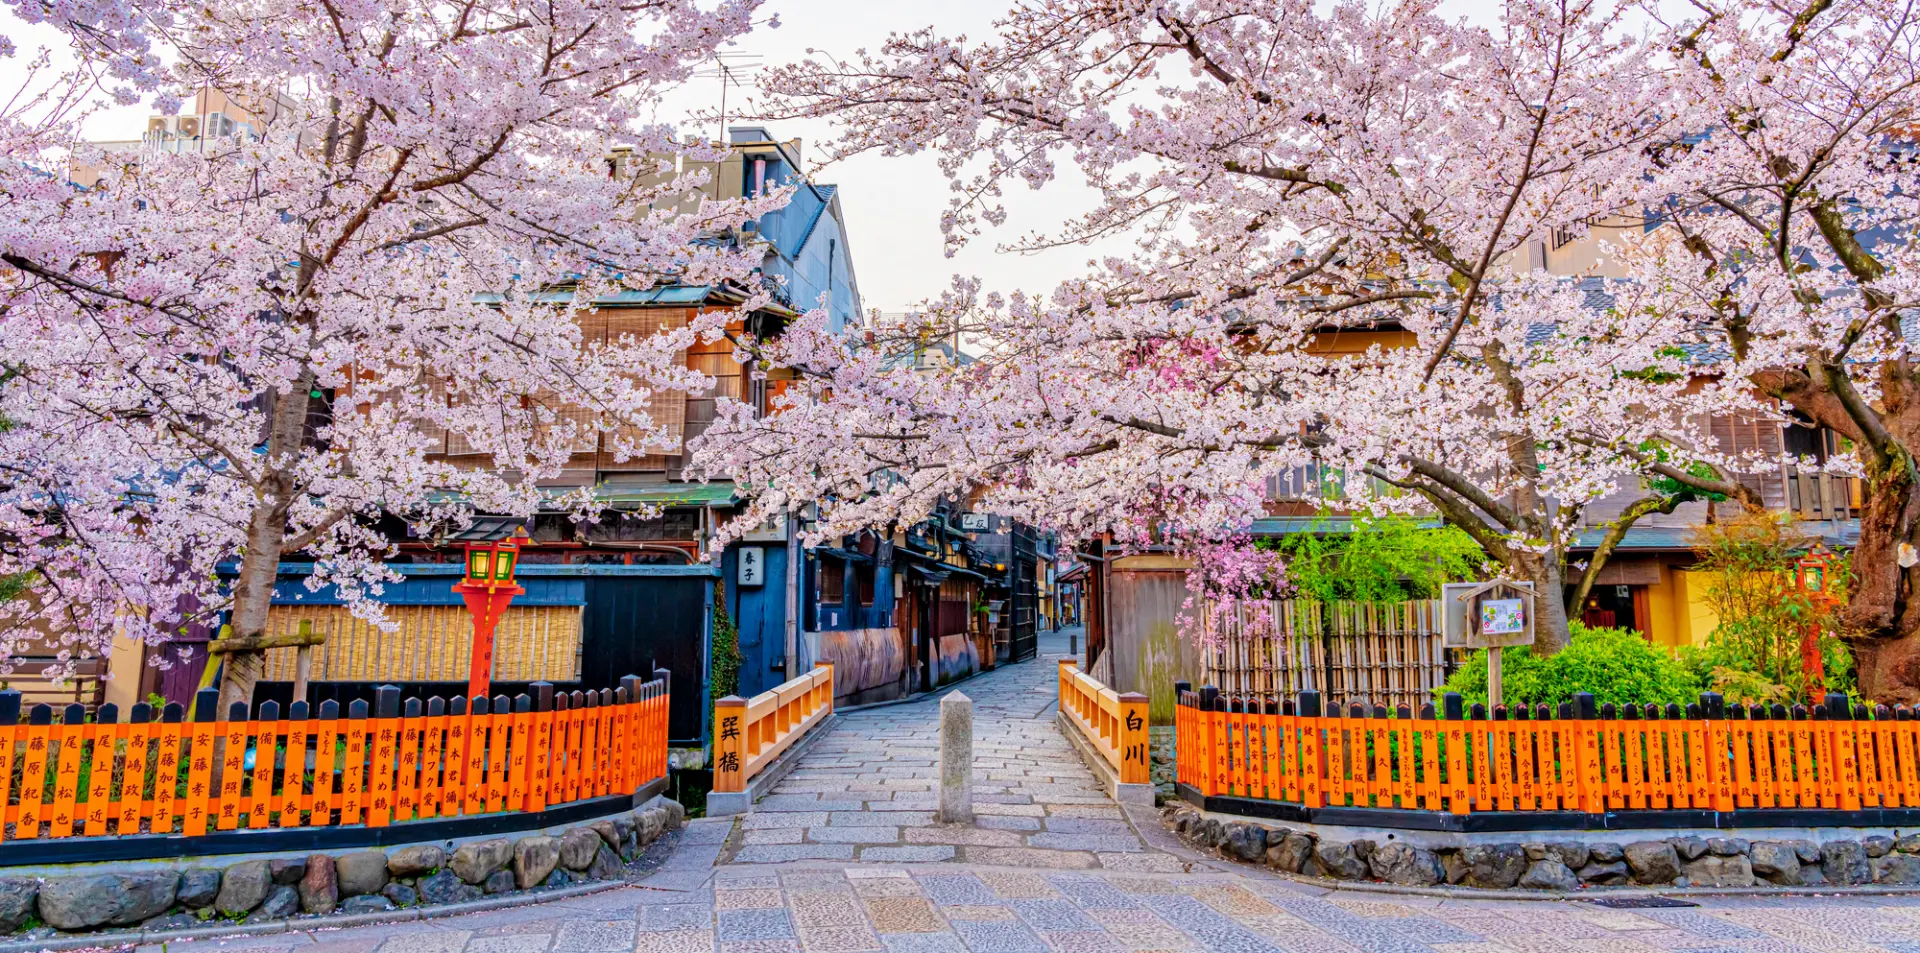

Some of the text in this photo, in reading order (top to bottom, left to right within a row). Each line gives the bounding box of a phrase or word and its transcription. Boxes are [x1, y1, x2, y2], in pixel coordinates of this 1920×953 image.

[718, 716, 740, 773] 巽橋
[1125, 709, 1144, 766] 白川
[1267, 724, 1276, 789] いづう
[1303, 725, 1315, 794] 鍵善良房
[1423, 730, 1437, 799] 弥す川
[1451, 730, 1465, 800] 原了郭
[1694, 729, 1706, 798] てっさい堂
[1716, 729, 1730, 798] かづら清老舗
[1798, 729, 1812, 798] 辻マチ子
[1861, 729, 1875, 797] 平田すだれ店
[21, 736, 45, 826] 藤原紀香
[55, 736, 77, 825] 尾上松也
[90, 735, 110, 823] 尾上右近
[156, 734, 177, 820] 安藤加奈子
[190, 733, 209, 819] 安藤孝子
[253, 732, 273, 816] 備前屋
[284, 731, 303, 814] 荒文香
[1331, 753, 1341, 796] おくむら
[1478, 750, 1487, 801] RYOKAKU
[1521, 758, 1532, 800] 今昔西村
[1544, 760, 1553, 800] フクナガ
[1566, 769, 1575, 799] バゴン
[1588, 760, 1599, 796] みかく
[1782, 758, 1791, 797] たんと
